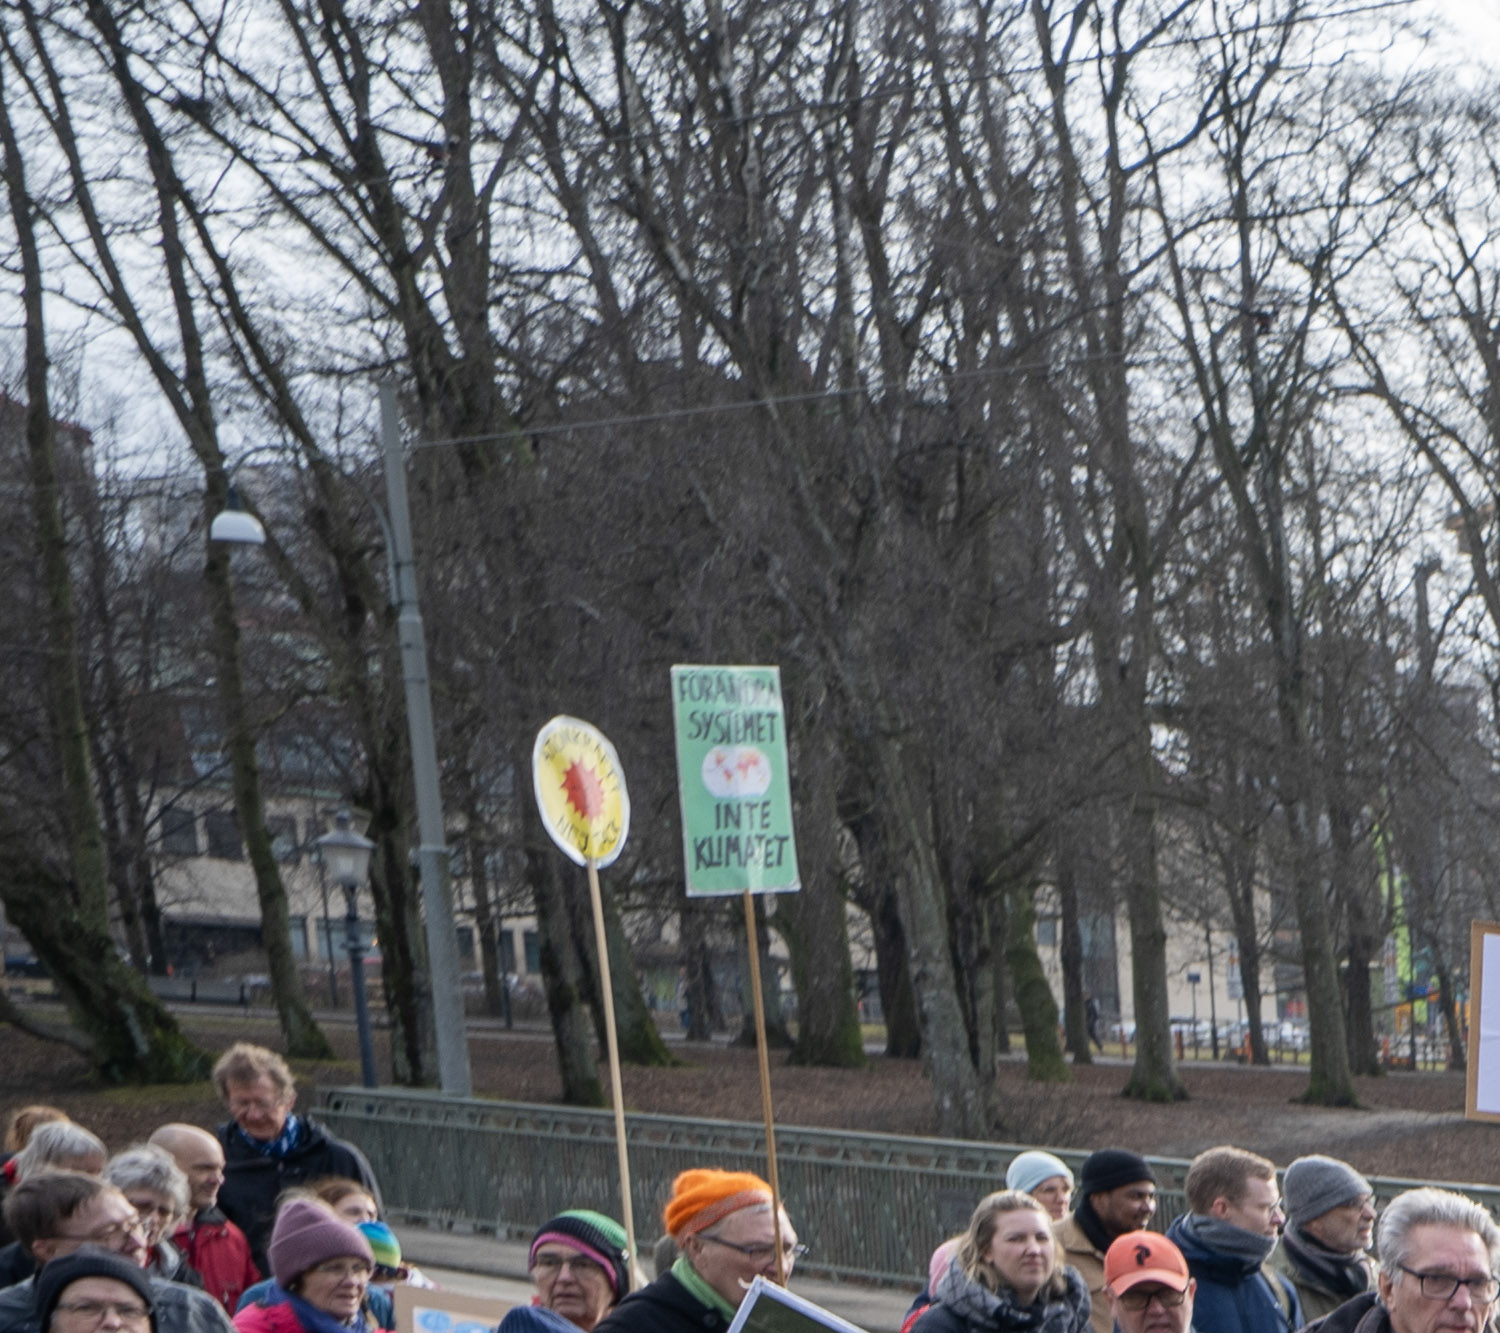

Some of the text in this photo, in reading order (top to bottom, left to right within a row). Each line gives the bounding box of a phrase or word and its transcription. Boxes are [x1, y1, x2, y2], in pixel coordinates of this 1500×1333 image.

[687, 710, 778, 744] SYSTEMET
[715, 800, 771, 830] INTE
[692, 834, 790, 872] KLIMATET
